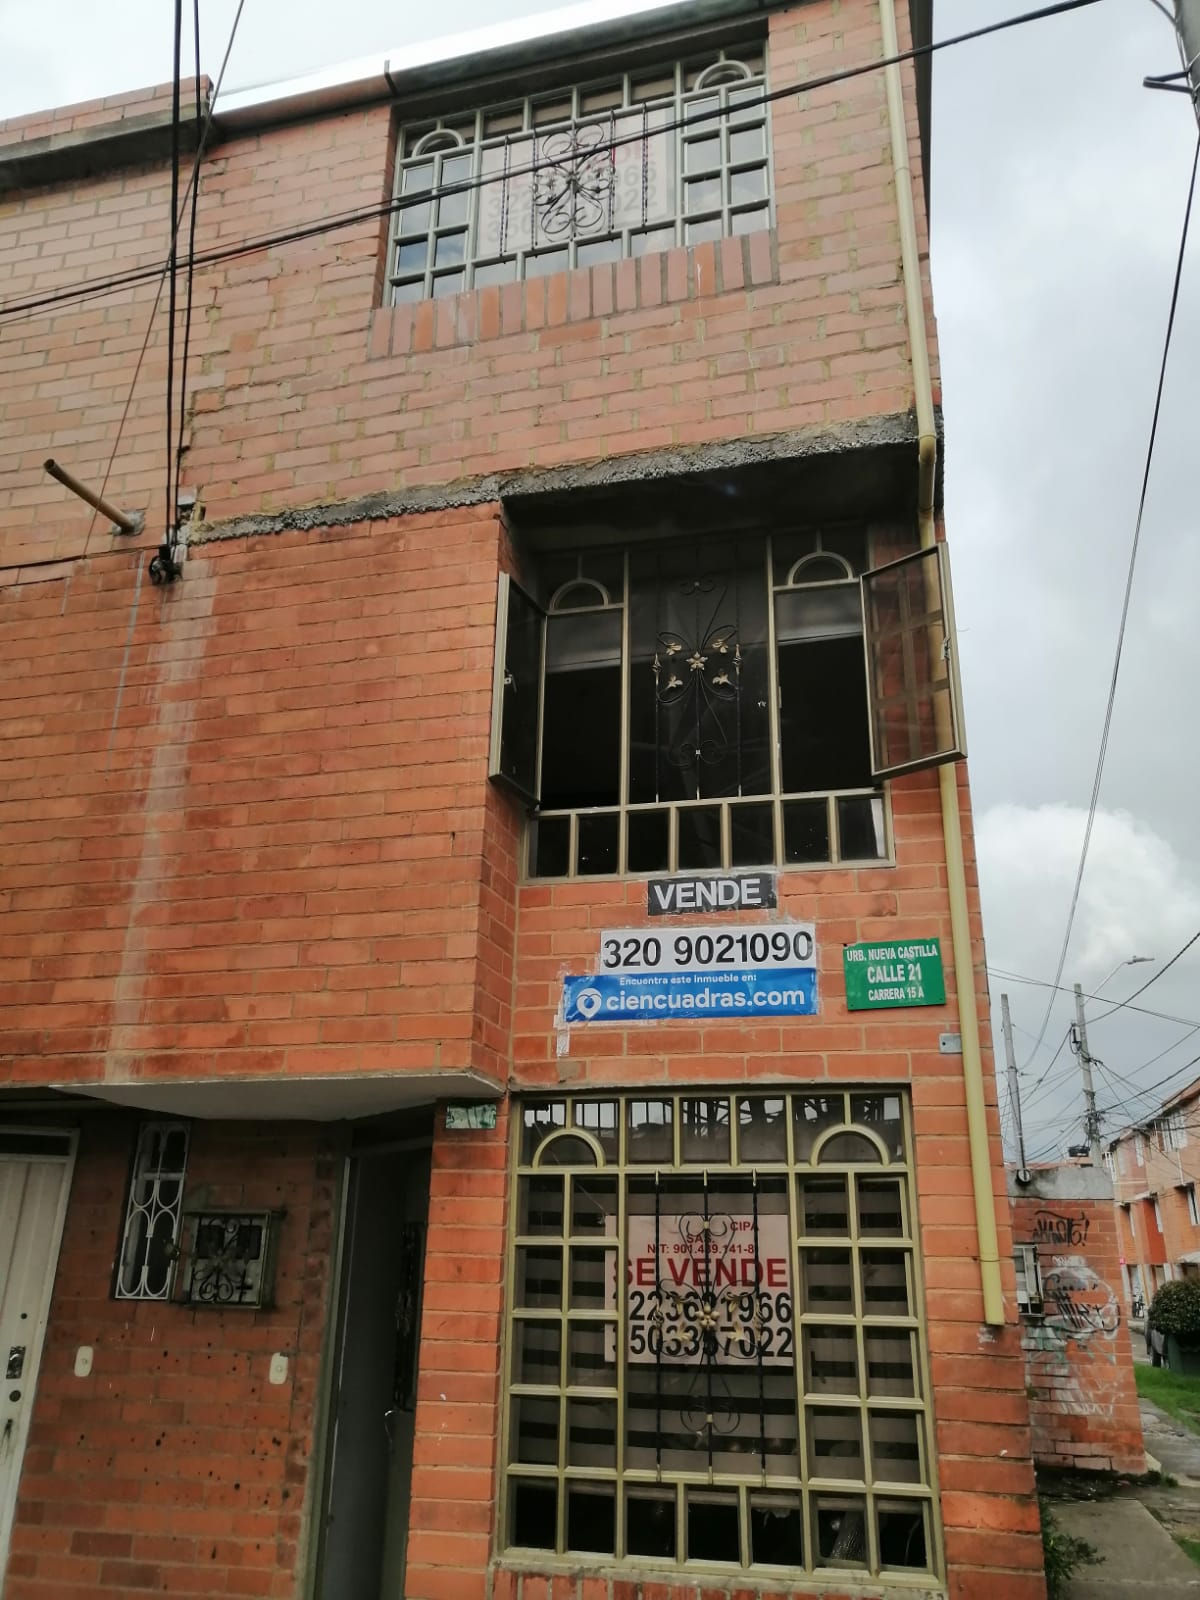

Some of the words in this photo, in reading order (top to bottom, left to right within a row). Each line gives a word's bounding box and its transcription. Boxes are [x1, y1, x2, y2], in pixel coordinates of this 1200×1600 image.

[654, 878, 762, 910] VENDE
[602, 937, 662, 969] 320
[673, 930, 813, 966] 9021090
[846, 950, 867, 962] URB.
[868, 947, 897, 961] NUEVA
[897, 944, 938, 959] CASTILLA
[619, 976, 668, 986] Encuentra
[670, 976, 692, 984] este
[741, 975, 757, 983] en:
[867, 964, 906, 984] CALLE
[908, 962, 922, 981] 21
[606, 987, 805, 1011] ciencuadras.com
[868, 987, 905, 1001] CARRERA
[907, 986, 917, 998] 15
[918, 985, 924, 998] A
[647, 1244, 670, 1254] NT:
[668, 1258, 788, 1288] VENDE
